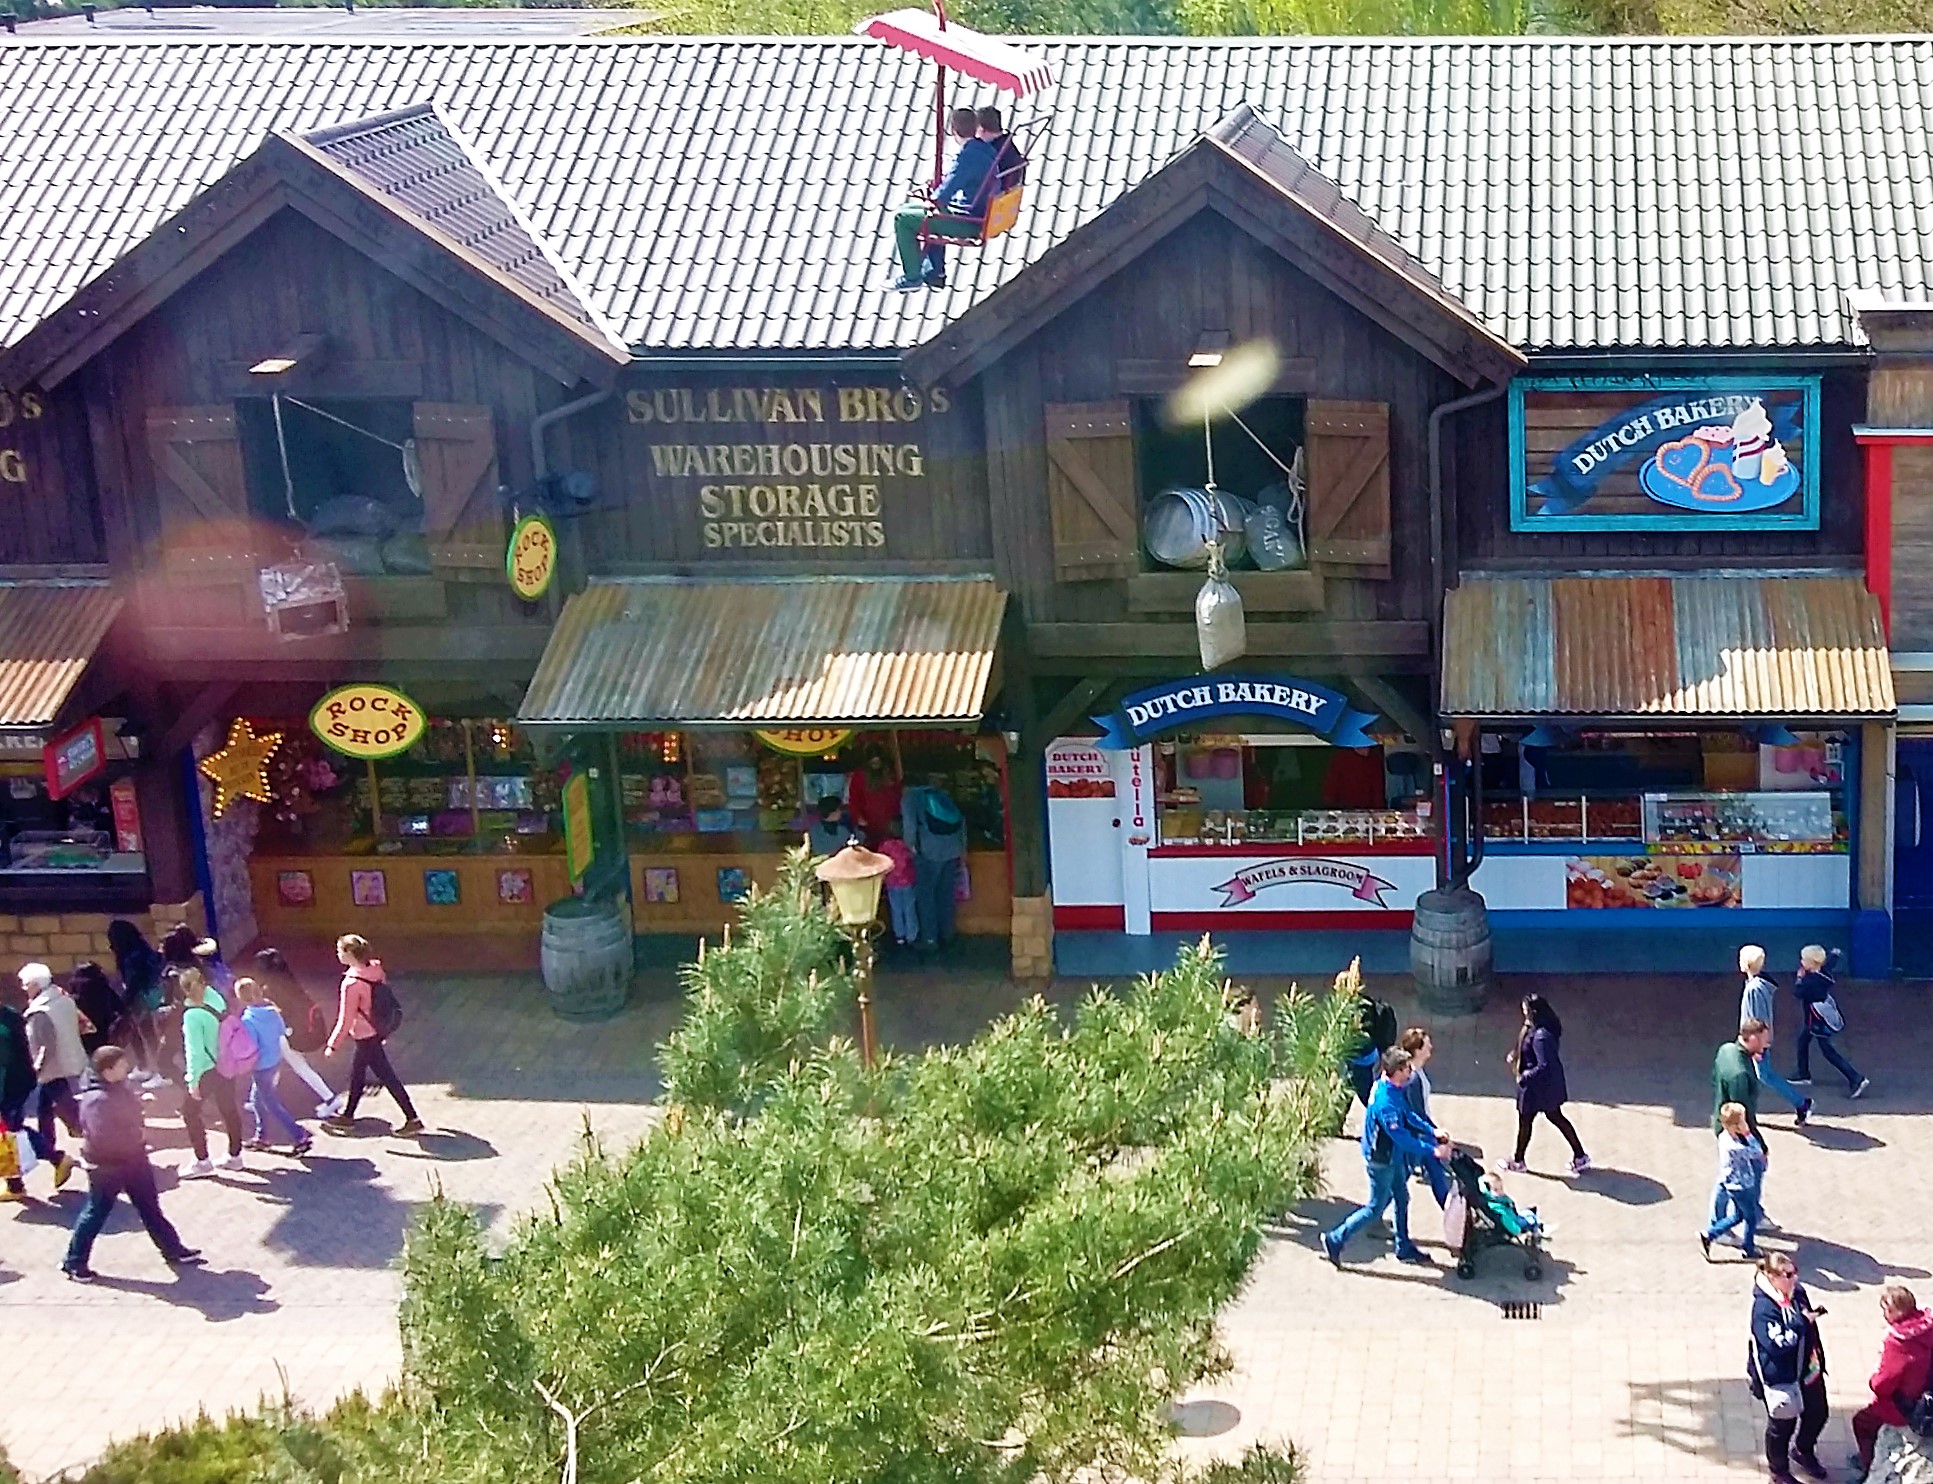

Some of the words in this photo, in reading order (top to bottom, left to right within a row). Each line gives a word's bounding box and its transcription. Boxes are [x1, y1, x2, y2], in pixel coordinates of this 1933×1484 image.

[627, 387, 824, 423] SULLIVAN
[1572, 416, 1654, 475] DUTCH
[1653, 395, 1763, 430] BAKERY
[650, 444, 925, 478] WAREHOUSING
[700, 484, 881, 519] STORAGE
[515, 531, 549, 565] ROCK
[703, 521, 886, 548] SPECIALISTS
[517, 554, 547, 586] SHOP
[326, 697, 412, 721] ROCK
[1127, 686, 1214, 727] DUTCH
[1216, 682, 1327, 716] BAKERY
[327, 722, 407, 744] SHOP
[1048, 765, 1103, 774] BAKERY
[1052, 752, 1099, 762] DUTCH
[1130, 750, 1144, 828] utella
[1289, 865, 1298, 876] &
[1300, 865, 1364, 884] SLAGROOM
